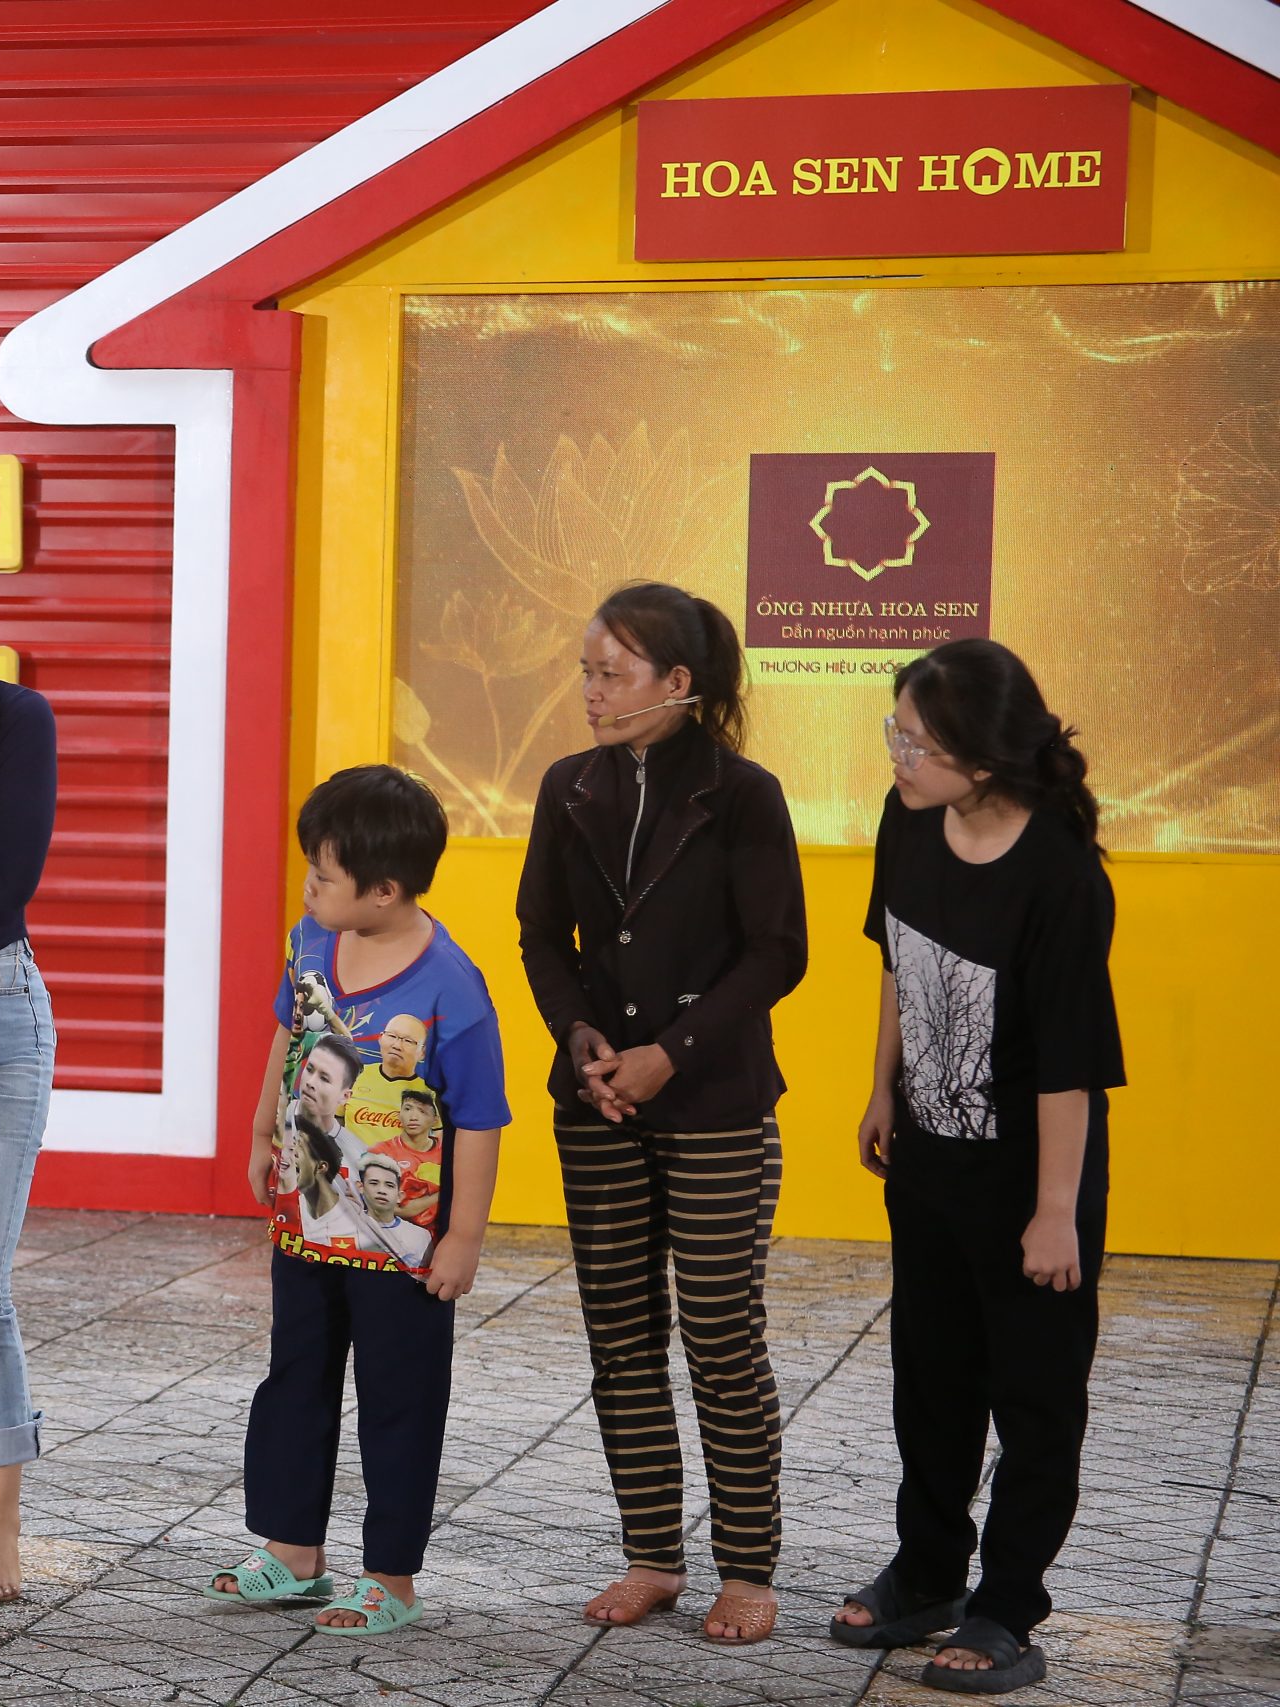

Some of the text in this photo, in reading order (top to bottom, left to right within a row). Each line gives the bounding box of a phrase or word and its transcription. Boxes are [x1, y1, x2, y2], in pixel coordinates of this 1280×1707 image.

[660, 147, 1103, 199] HOA SEN HOME
[810, 599, 873, 620] NHỰA
[880, 601, 928, 617] HOA
[933, 601, 980, 617] SEN
[870, 625, 908, 643] hạnh
[912, 624, 952, 641] phúc
[825, 659, 857, 675] HIỆU
[354, 1106, 404, 1128] Coca-Co
